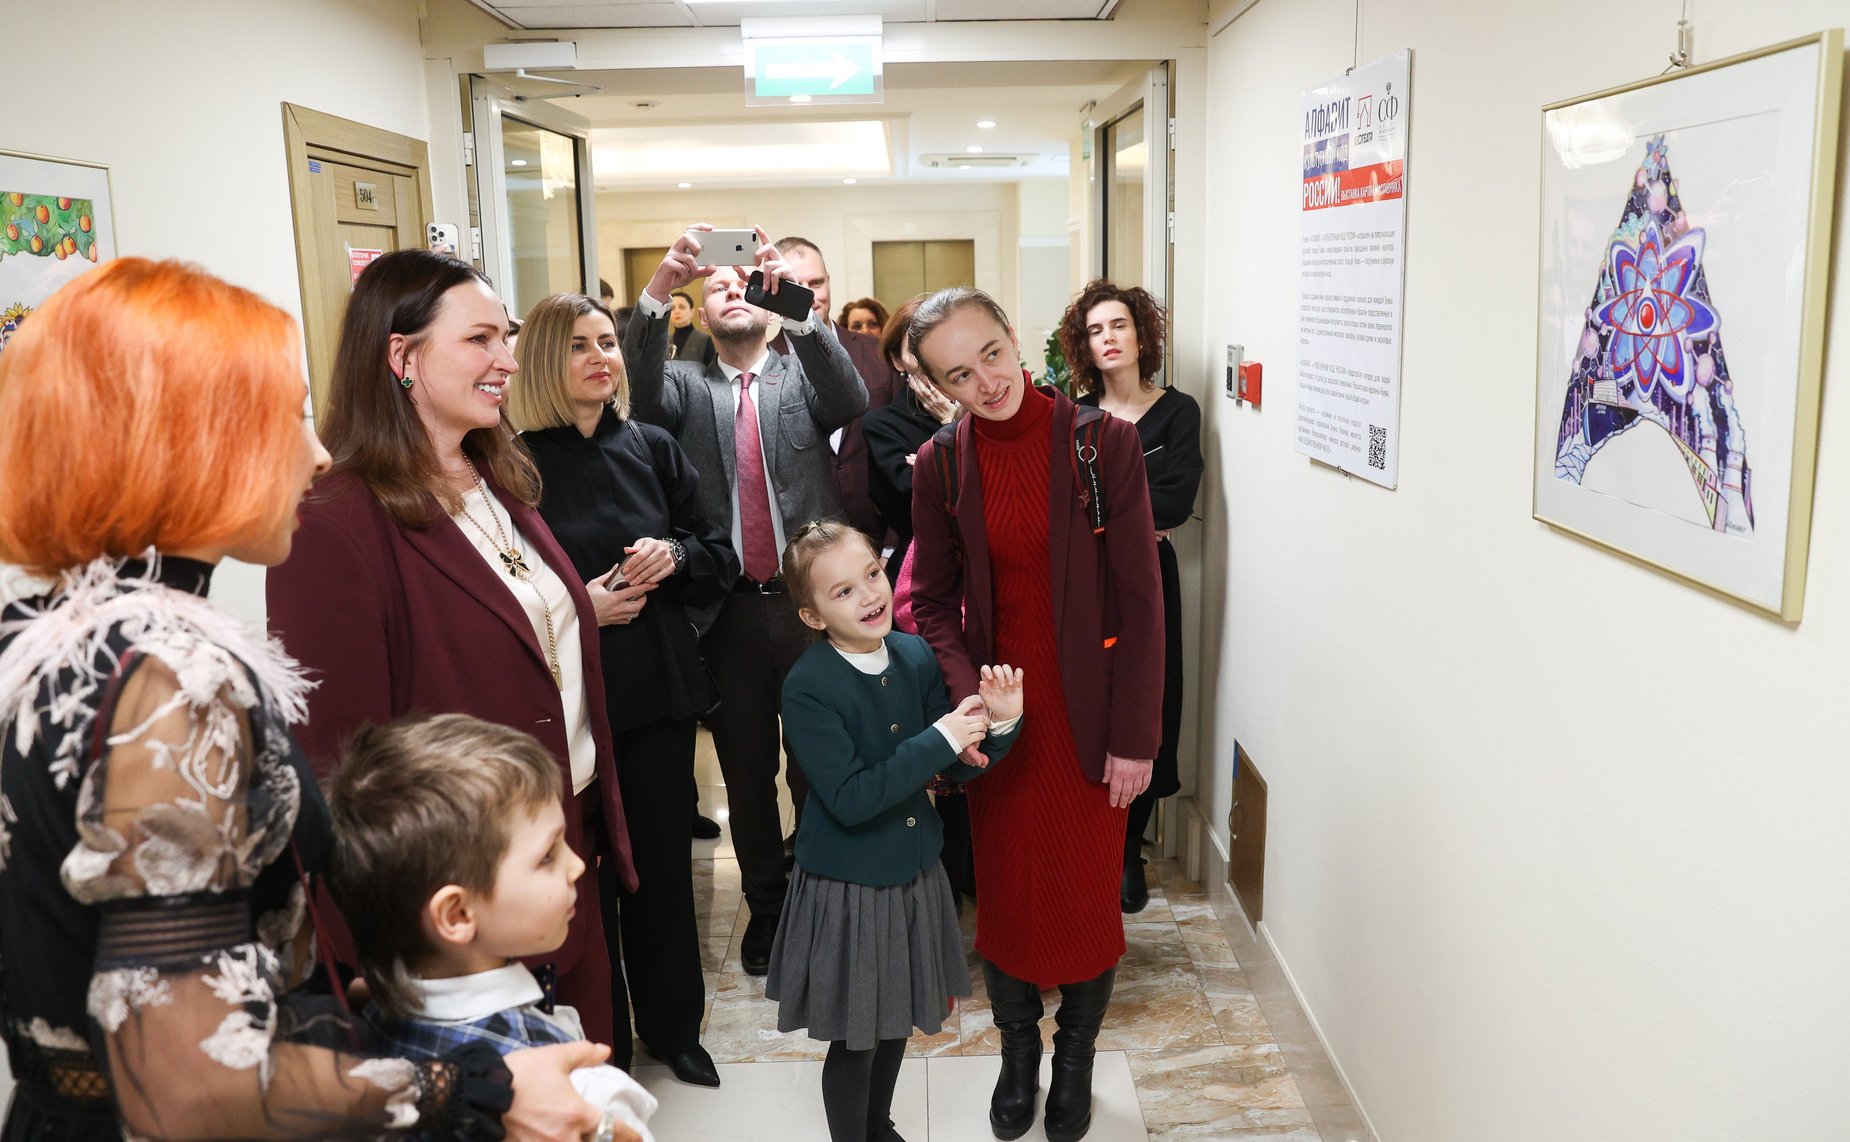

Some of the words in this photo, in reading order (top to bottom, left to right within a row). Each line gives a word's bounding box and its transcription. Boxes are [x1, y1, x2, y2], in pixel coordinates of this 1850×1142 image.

[1304, 96, 1351, 140] АЛФАВИТ
[1378, 96, 1399, 123] СФ
[1303, 177, 1340, 209] РОССИИ!
